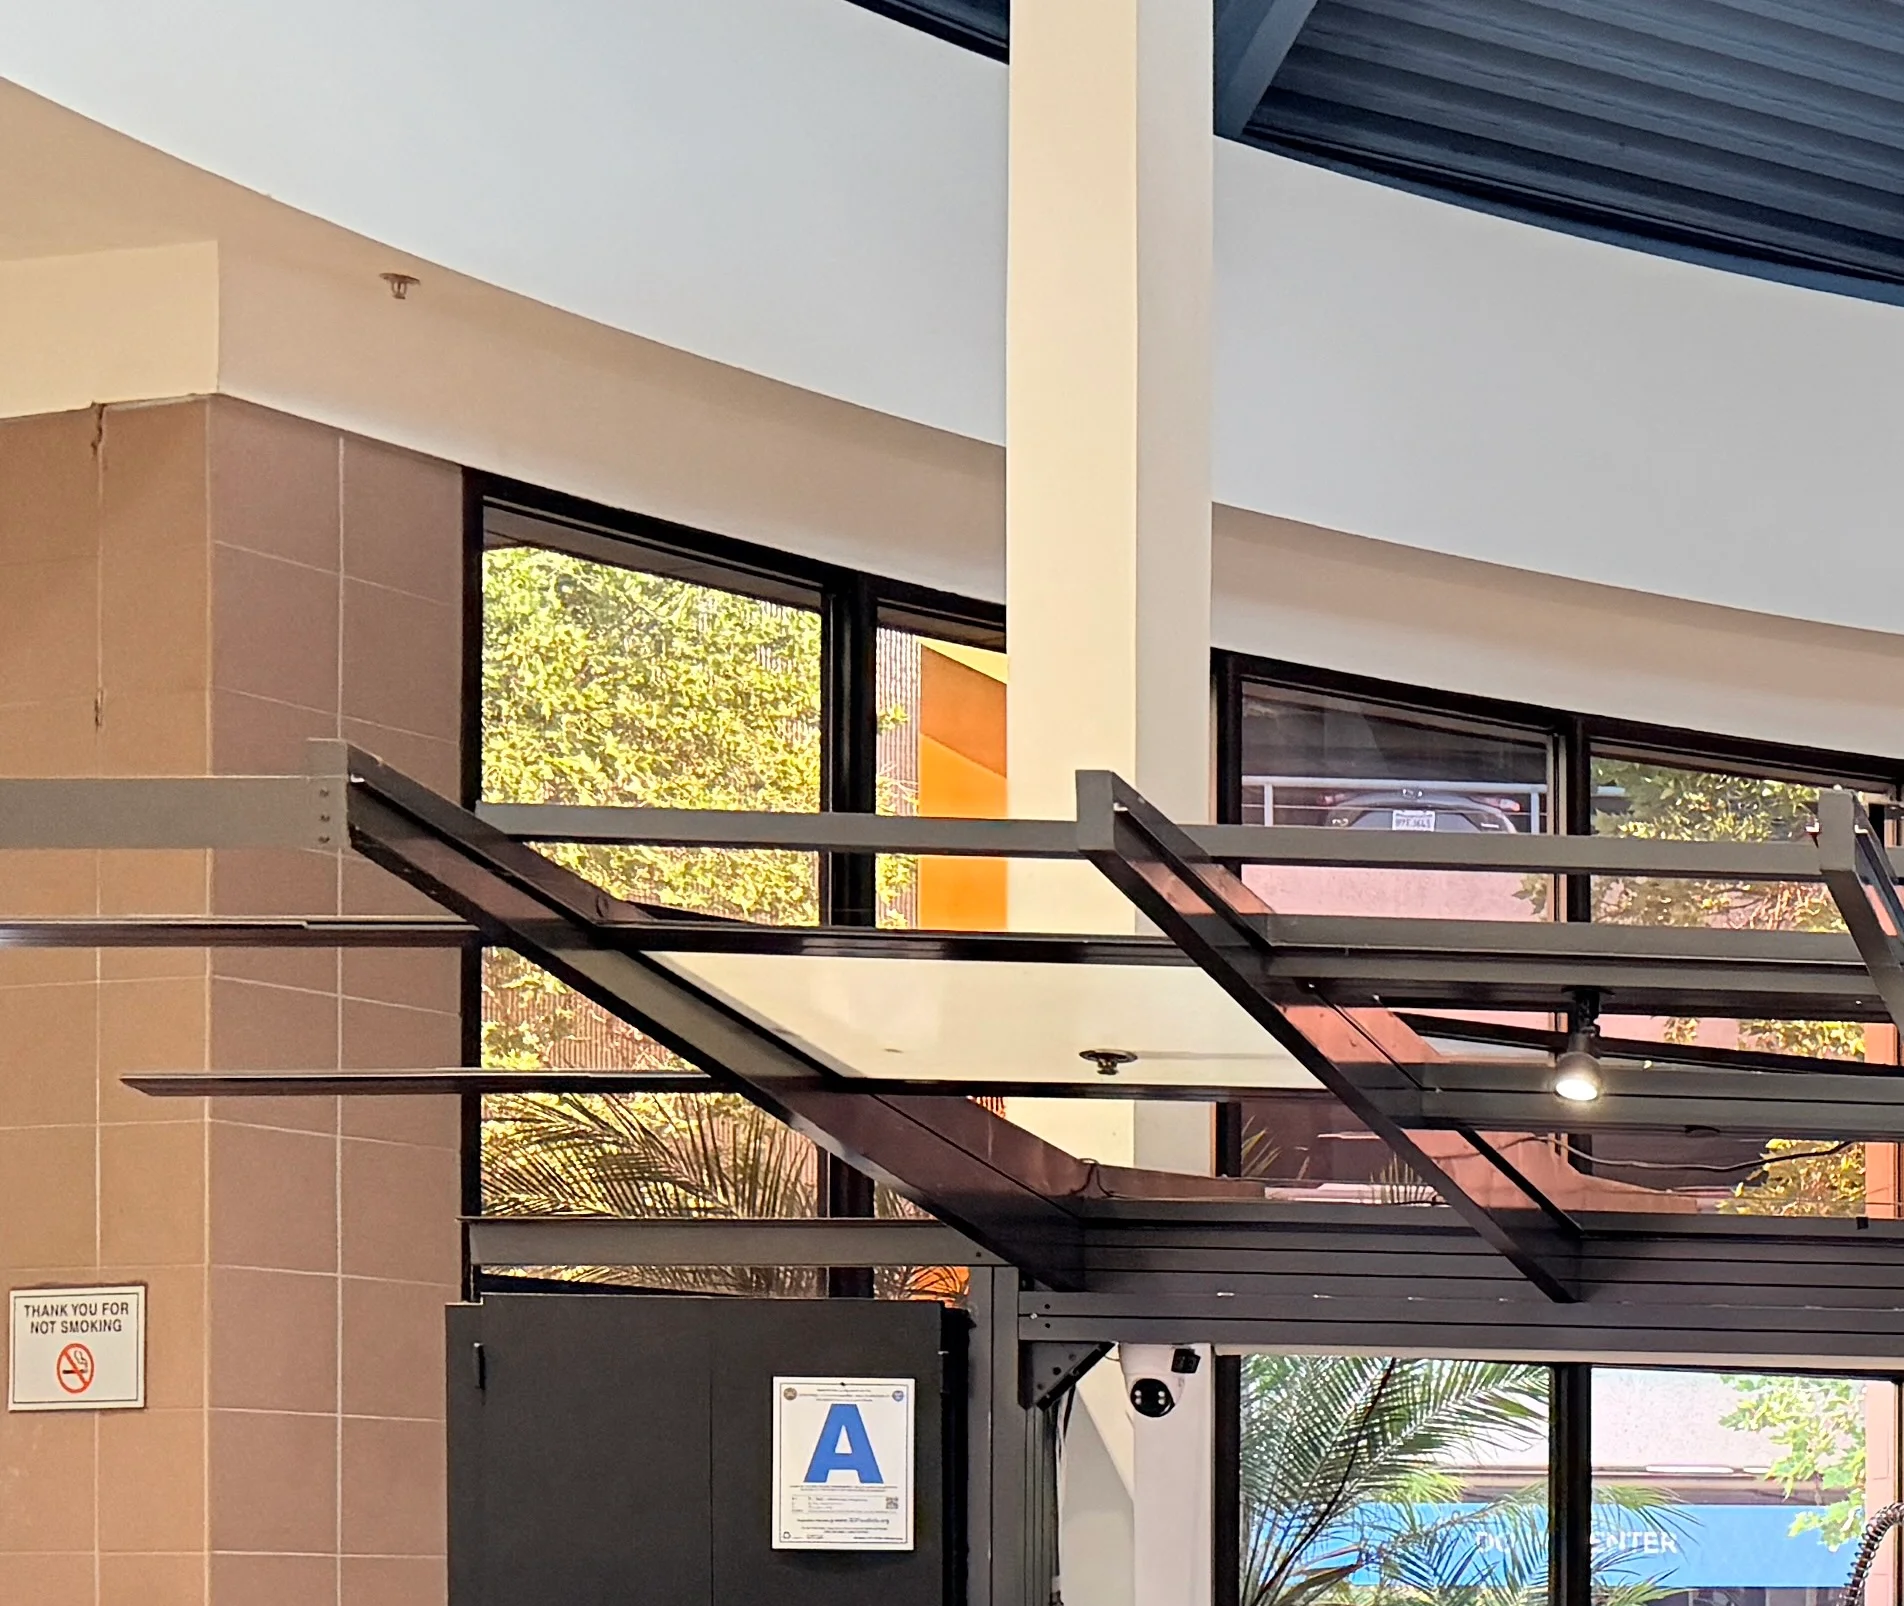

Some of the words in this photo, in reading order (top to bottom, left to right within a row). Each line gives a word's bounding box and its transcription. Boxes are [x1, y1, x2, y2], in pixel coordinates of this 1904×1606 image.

[24, 1304, 68, 1317] THANK
[71, 1303, 97, 1316] YOU
[102, 1302, 128, 1315] FOR
[30, 1320, 56, 1334] NOT
[61, 1319, 122, 1333] SMOKING
[803, 1403, 884, 1484] A
